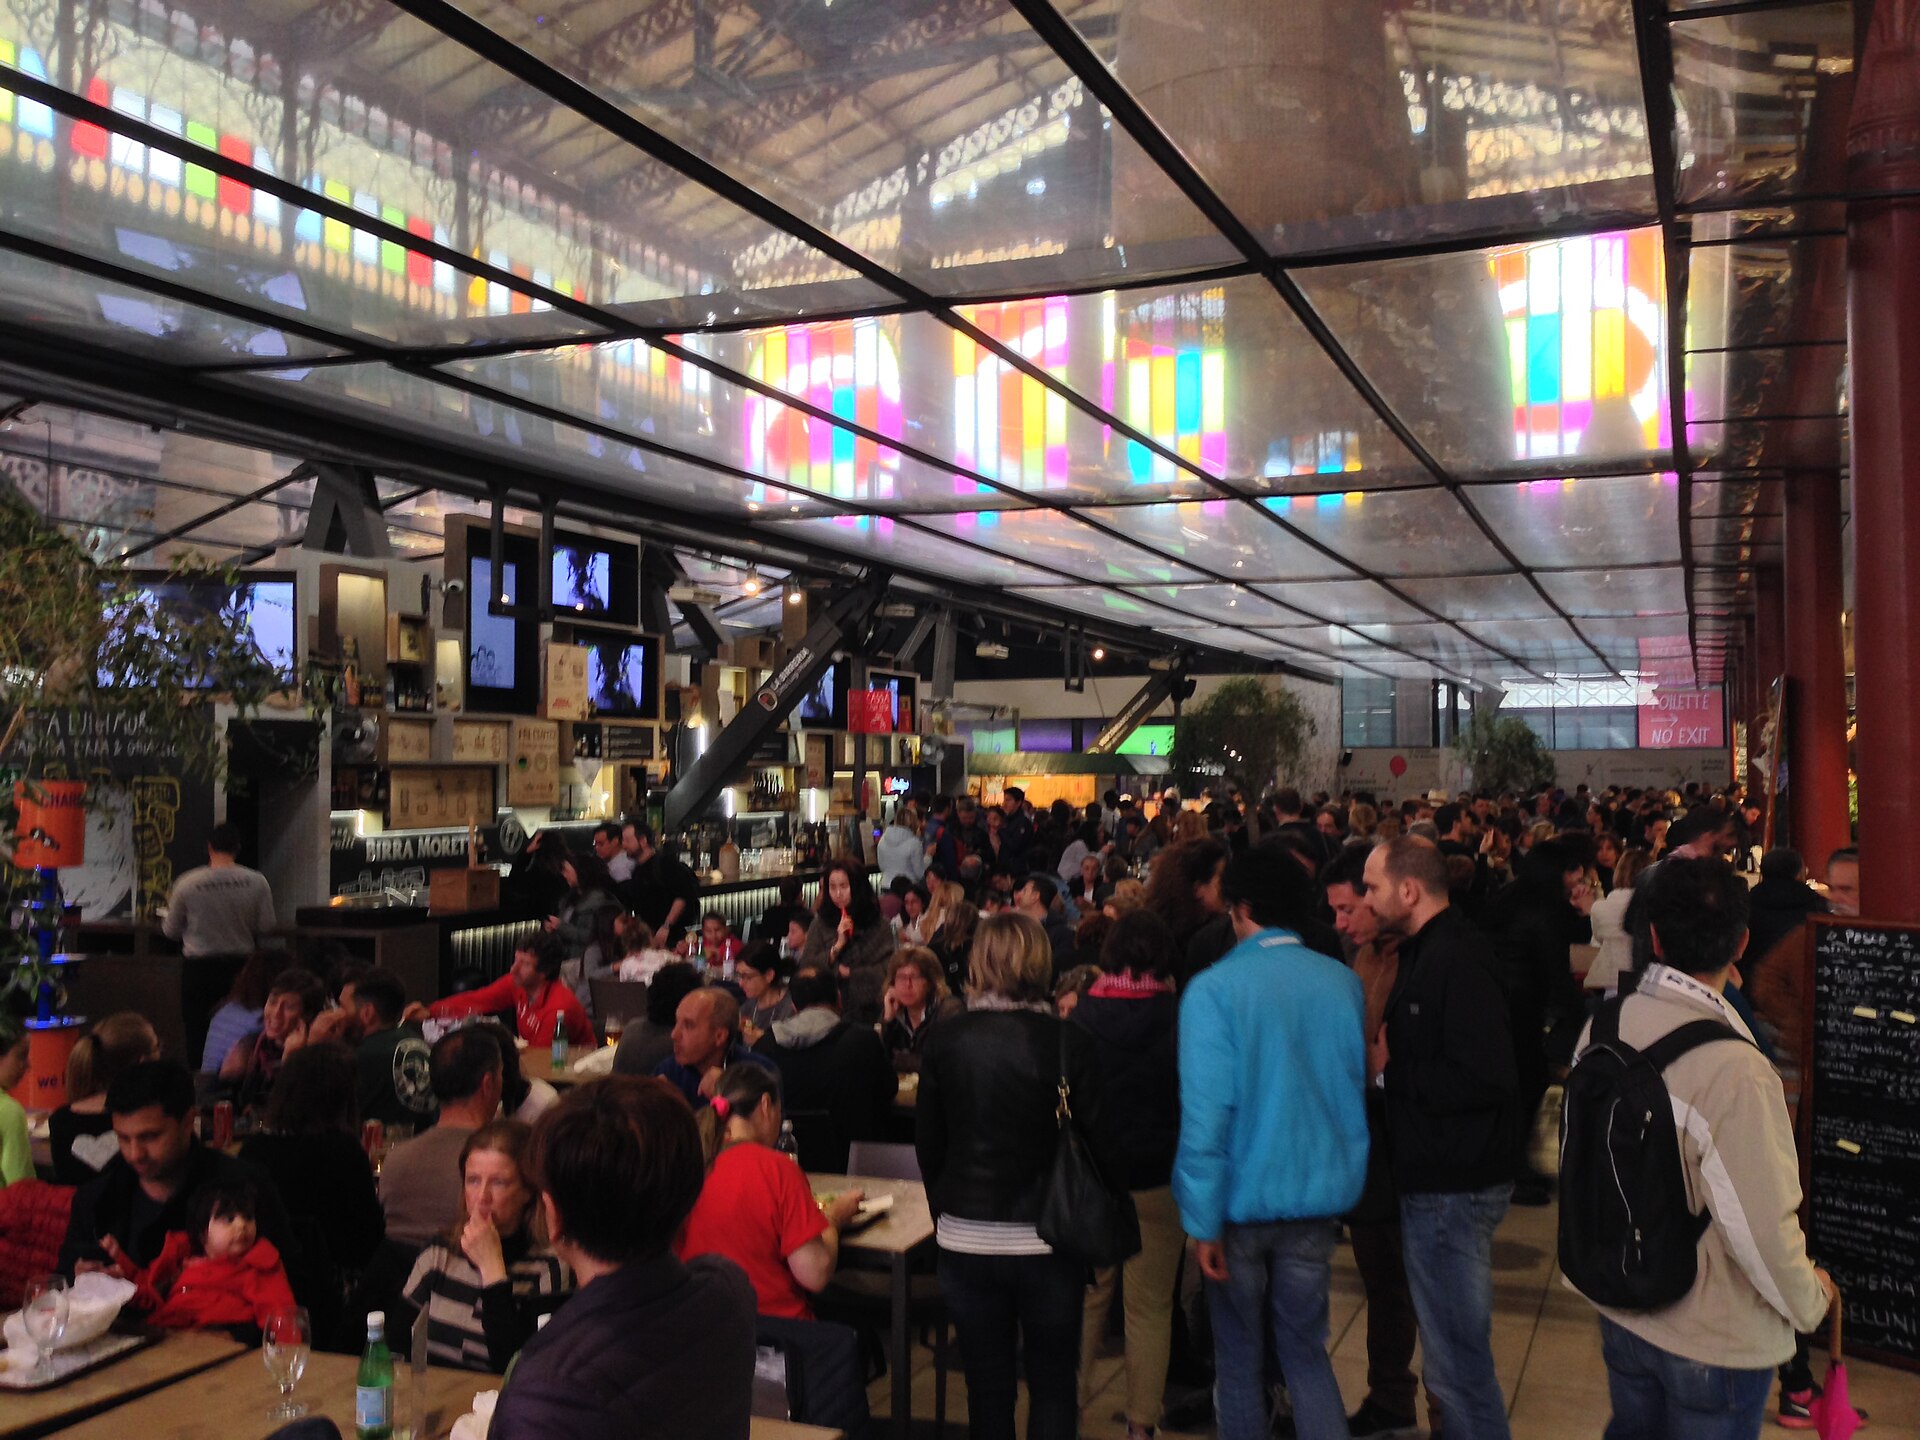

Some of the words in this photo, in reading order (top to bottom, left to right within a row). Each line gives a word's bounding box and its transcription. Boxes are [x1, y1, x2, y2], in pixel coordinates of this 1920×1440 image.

[1651, 728, 1674, 745] NO
[1678, 726, 1711, 745] EXIT
[366, 837, 414, 863] BIRRA
